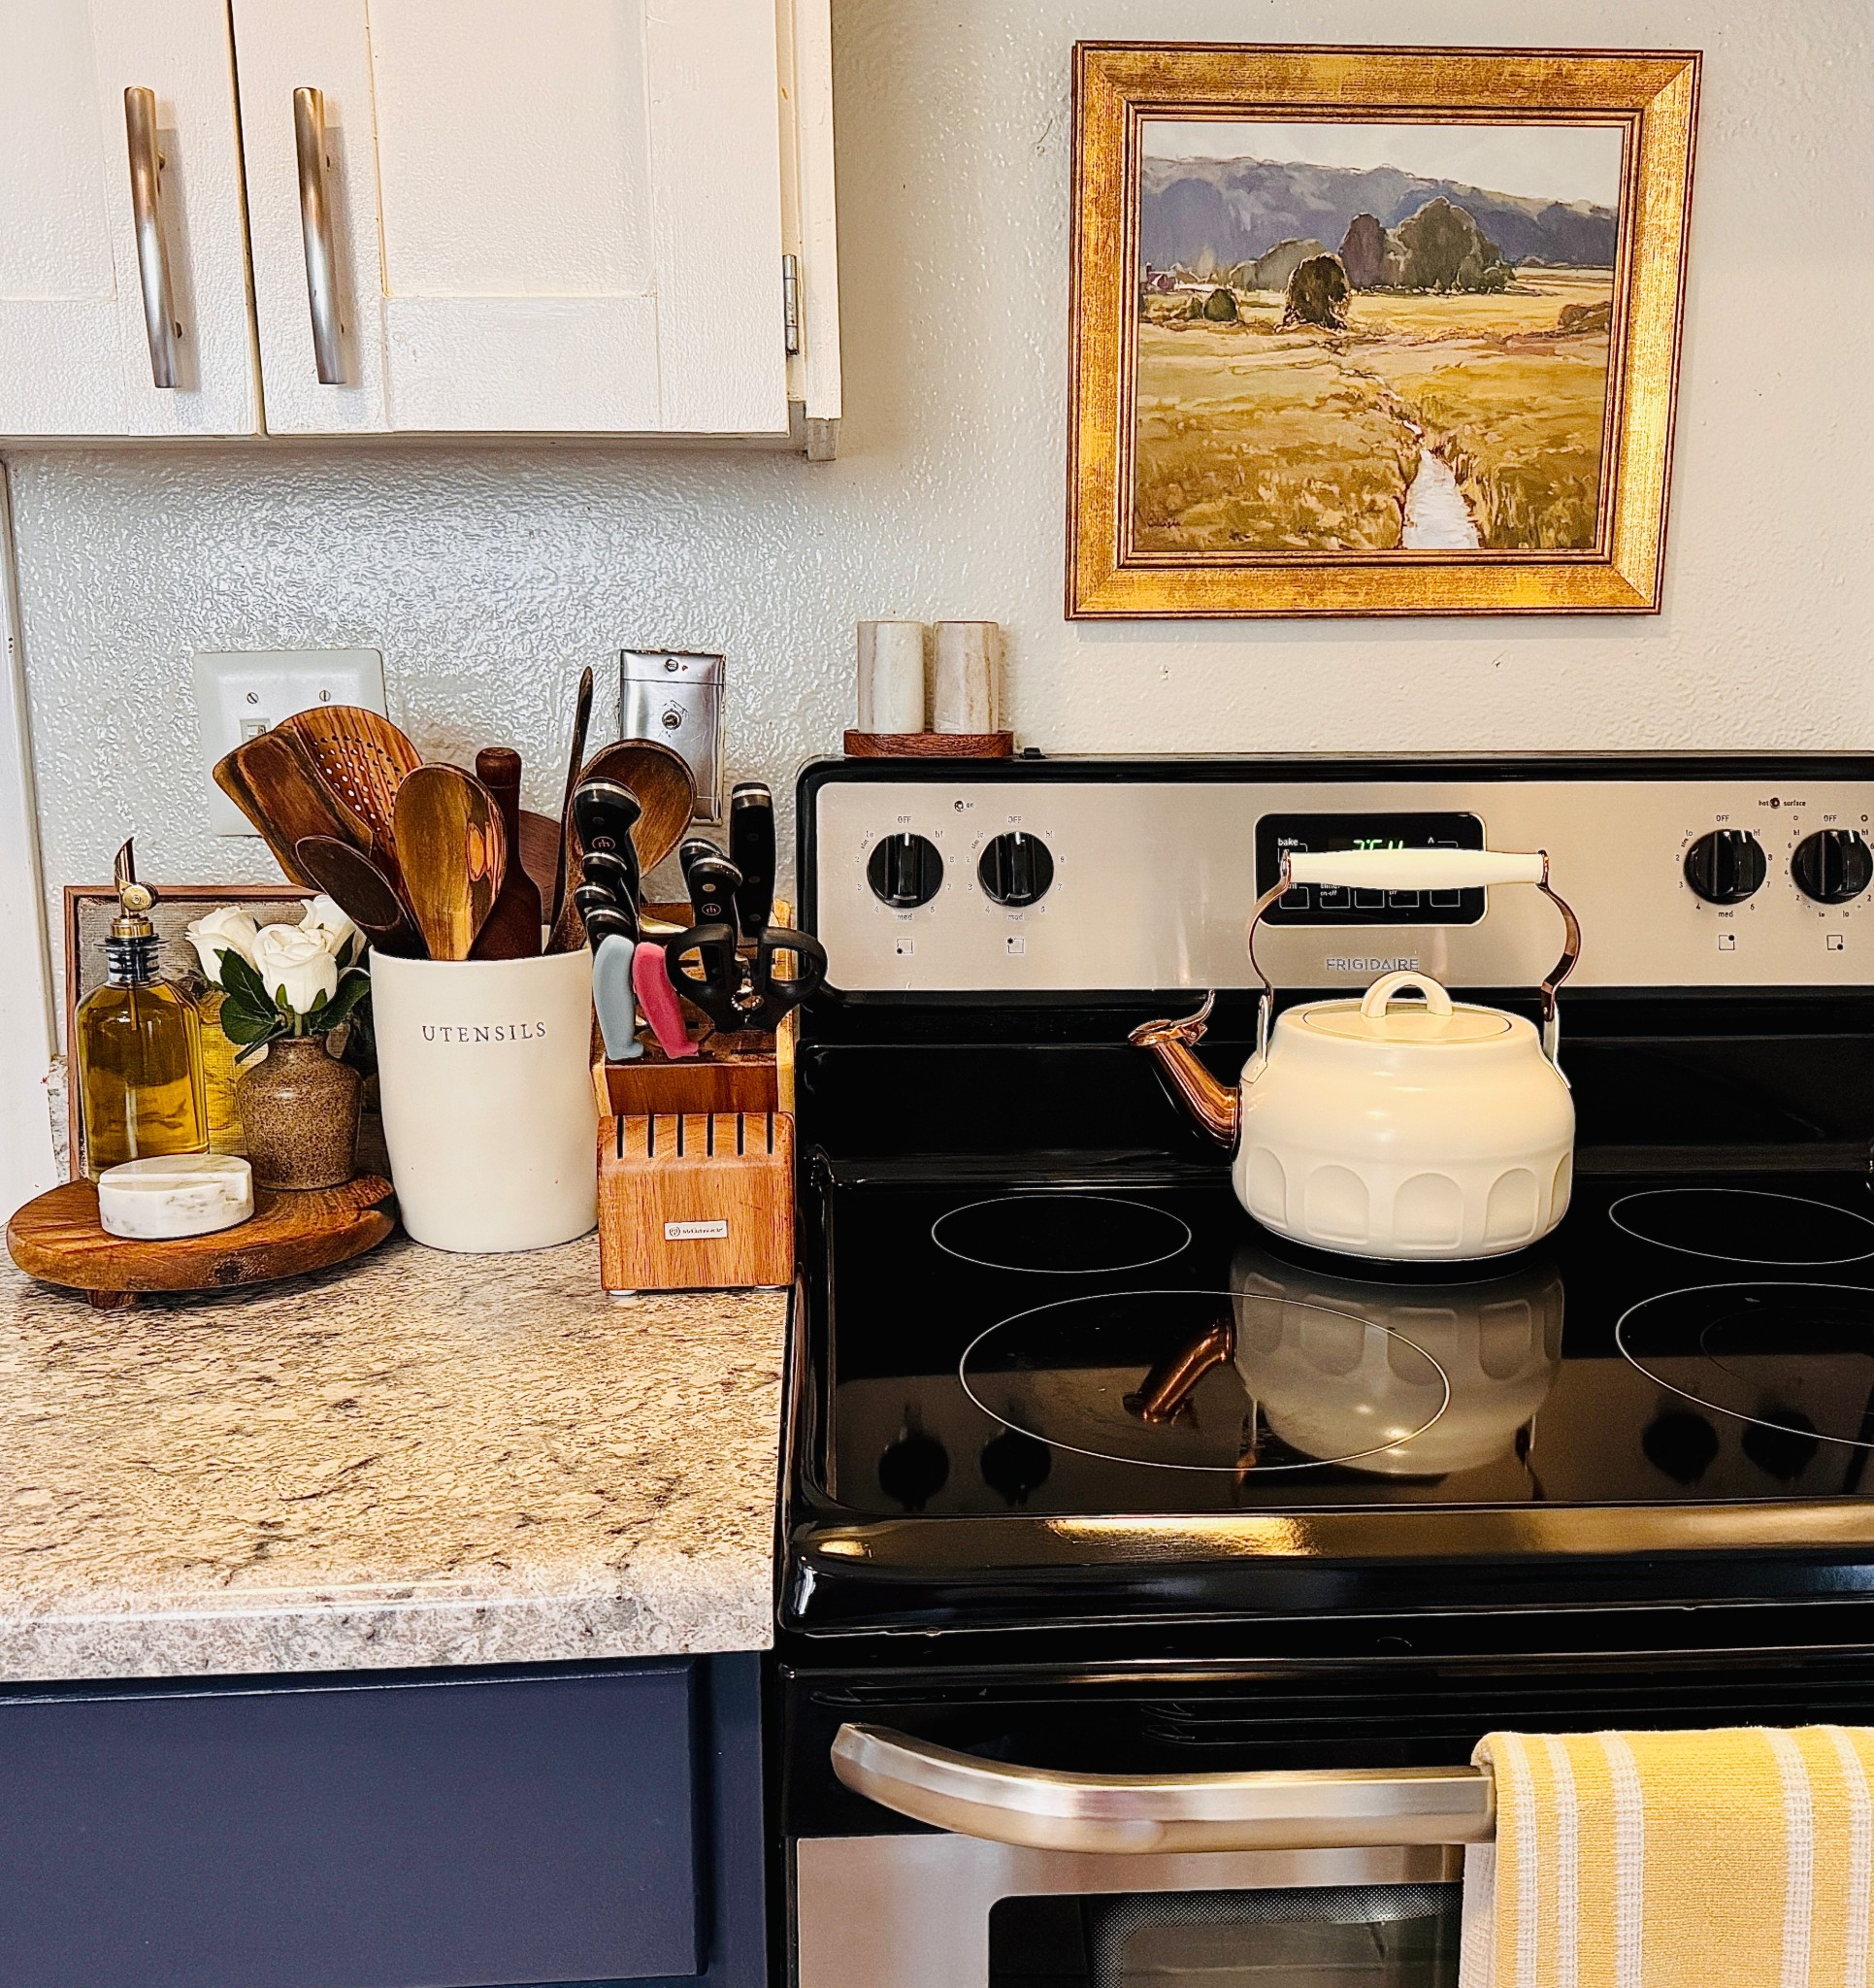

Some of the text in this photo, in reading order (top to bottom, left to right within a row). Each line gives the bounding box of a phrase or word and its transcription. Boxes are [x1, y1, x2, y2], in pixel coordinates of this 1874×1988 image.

[897, 815, 912, 824] OFF
[1007, 815, 1022, 824] OFF
[1277, 837, 1299, 846] bake
[897, 912, 913, 921] med
[1326, 958, 1419, 971] FRIGIDAIRE
[421, 1021, 546, 1043] UTENSILS
